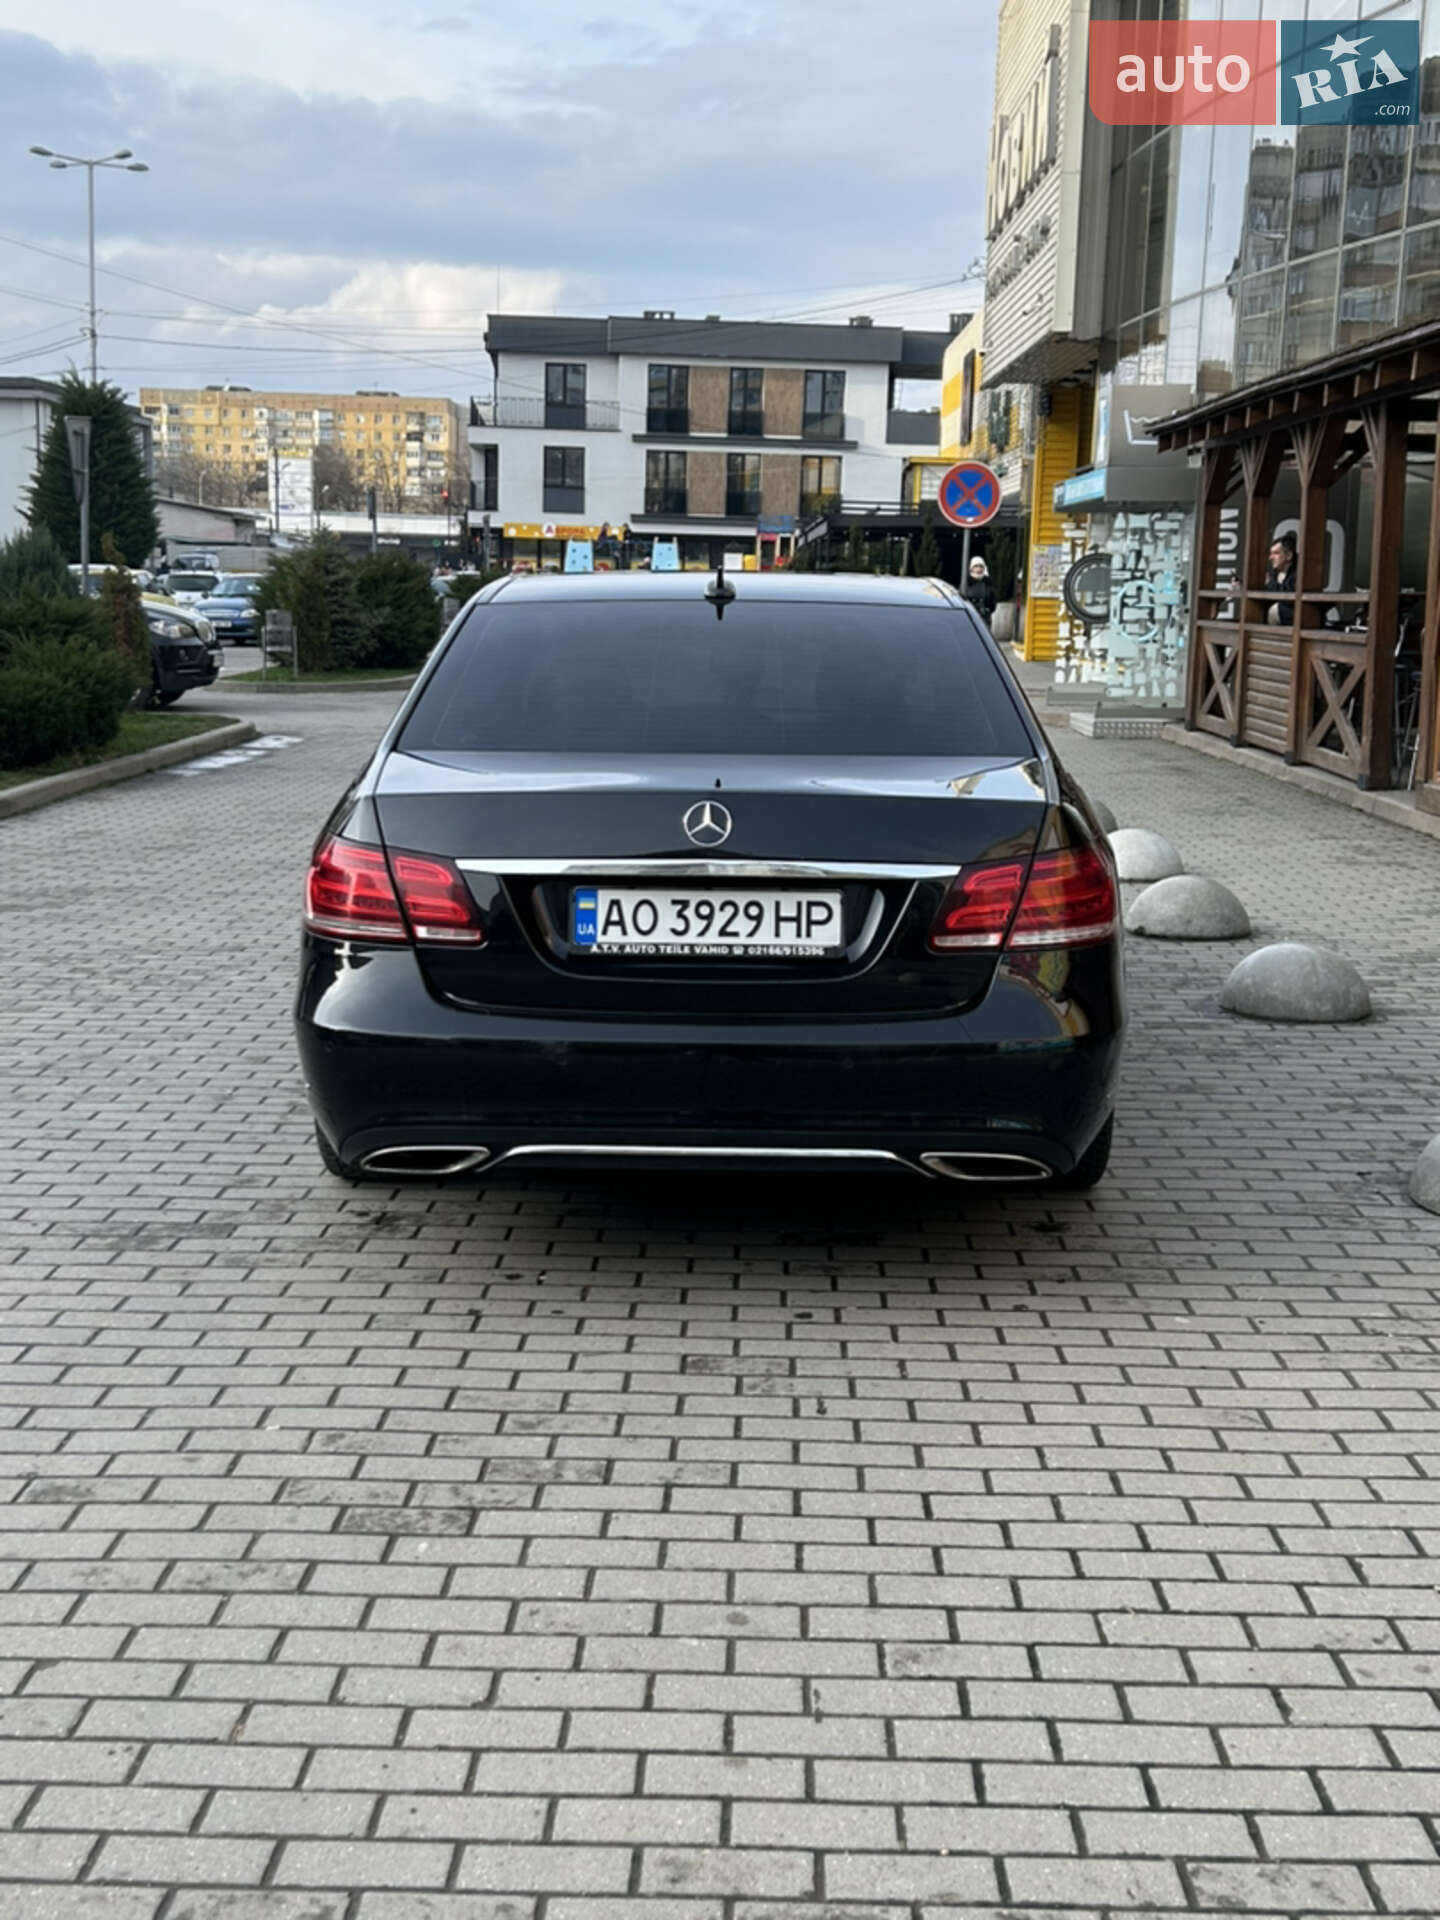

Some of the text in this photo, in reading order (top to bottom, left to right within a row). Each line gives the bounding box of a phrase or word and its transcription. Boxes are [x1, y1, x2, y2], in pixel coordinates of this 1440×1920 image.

[600, 899, 834, 938] AO 3929 HP
[577, 924, 596, 934] UA
[624, 945, 656, 954] AUTO
[660, 945, 691, 954] TEILE
